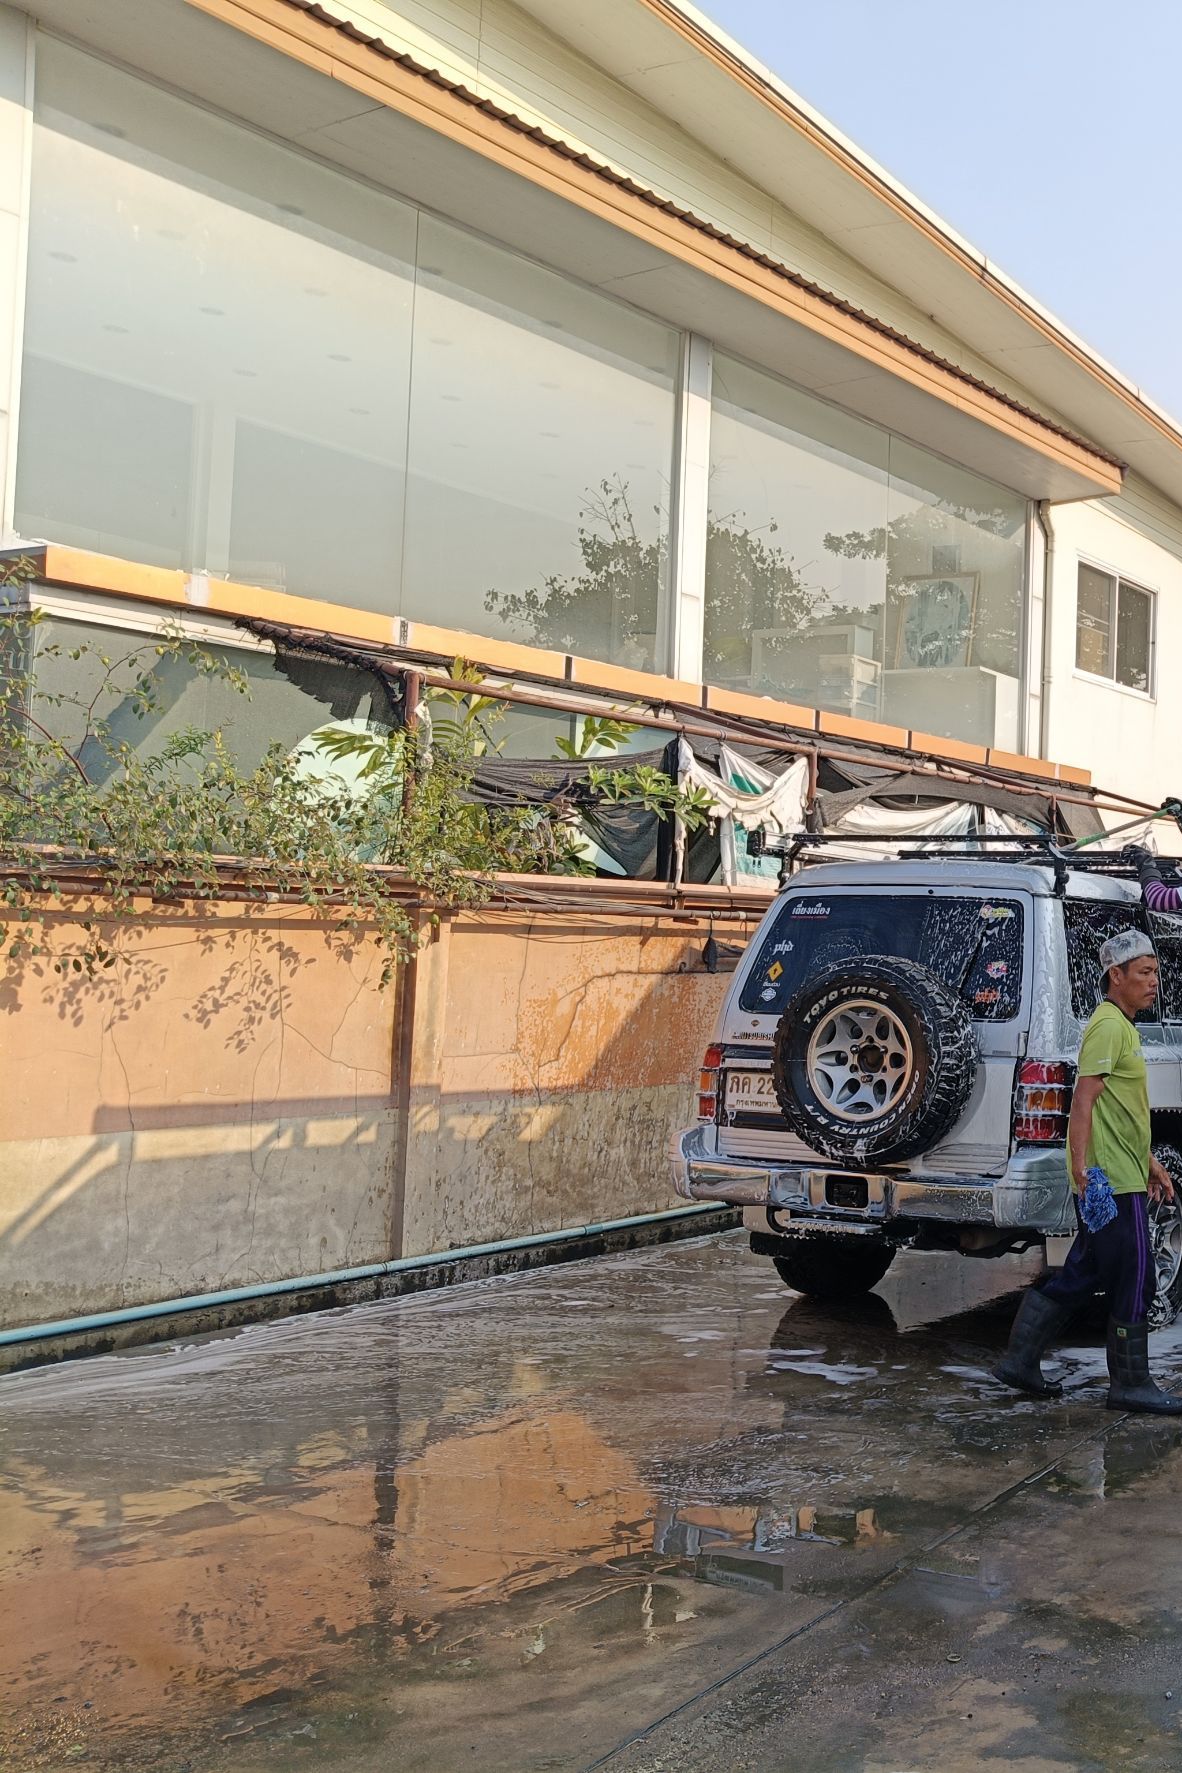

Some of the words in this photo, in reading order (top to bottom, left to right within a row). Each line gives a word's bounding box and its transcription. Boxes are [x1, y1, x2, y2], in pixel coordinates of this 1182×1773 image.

[803, 989, 839, 1024] TOYO
[840, 986, 890, 1000] TIRES
[756, 1076, 775, 1096] 22
[898, 1070, 920, 1115] OPEN
[830, 1114, 897, 1136] COUNTRY
